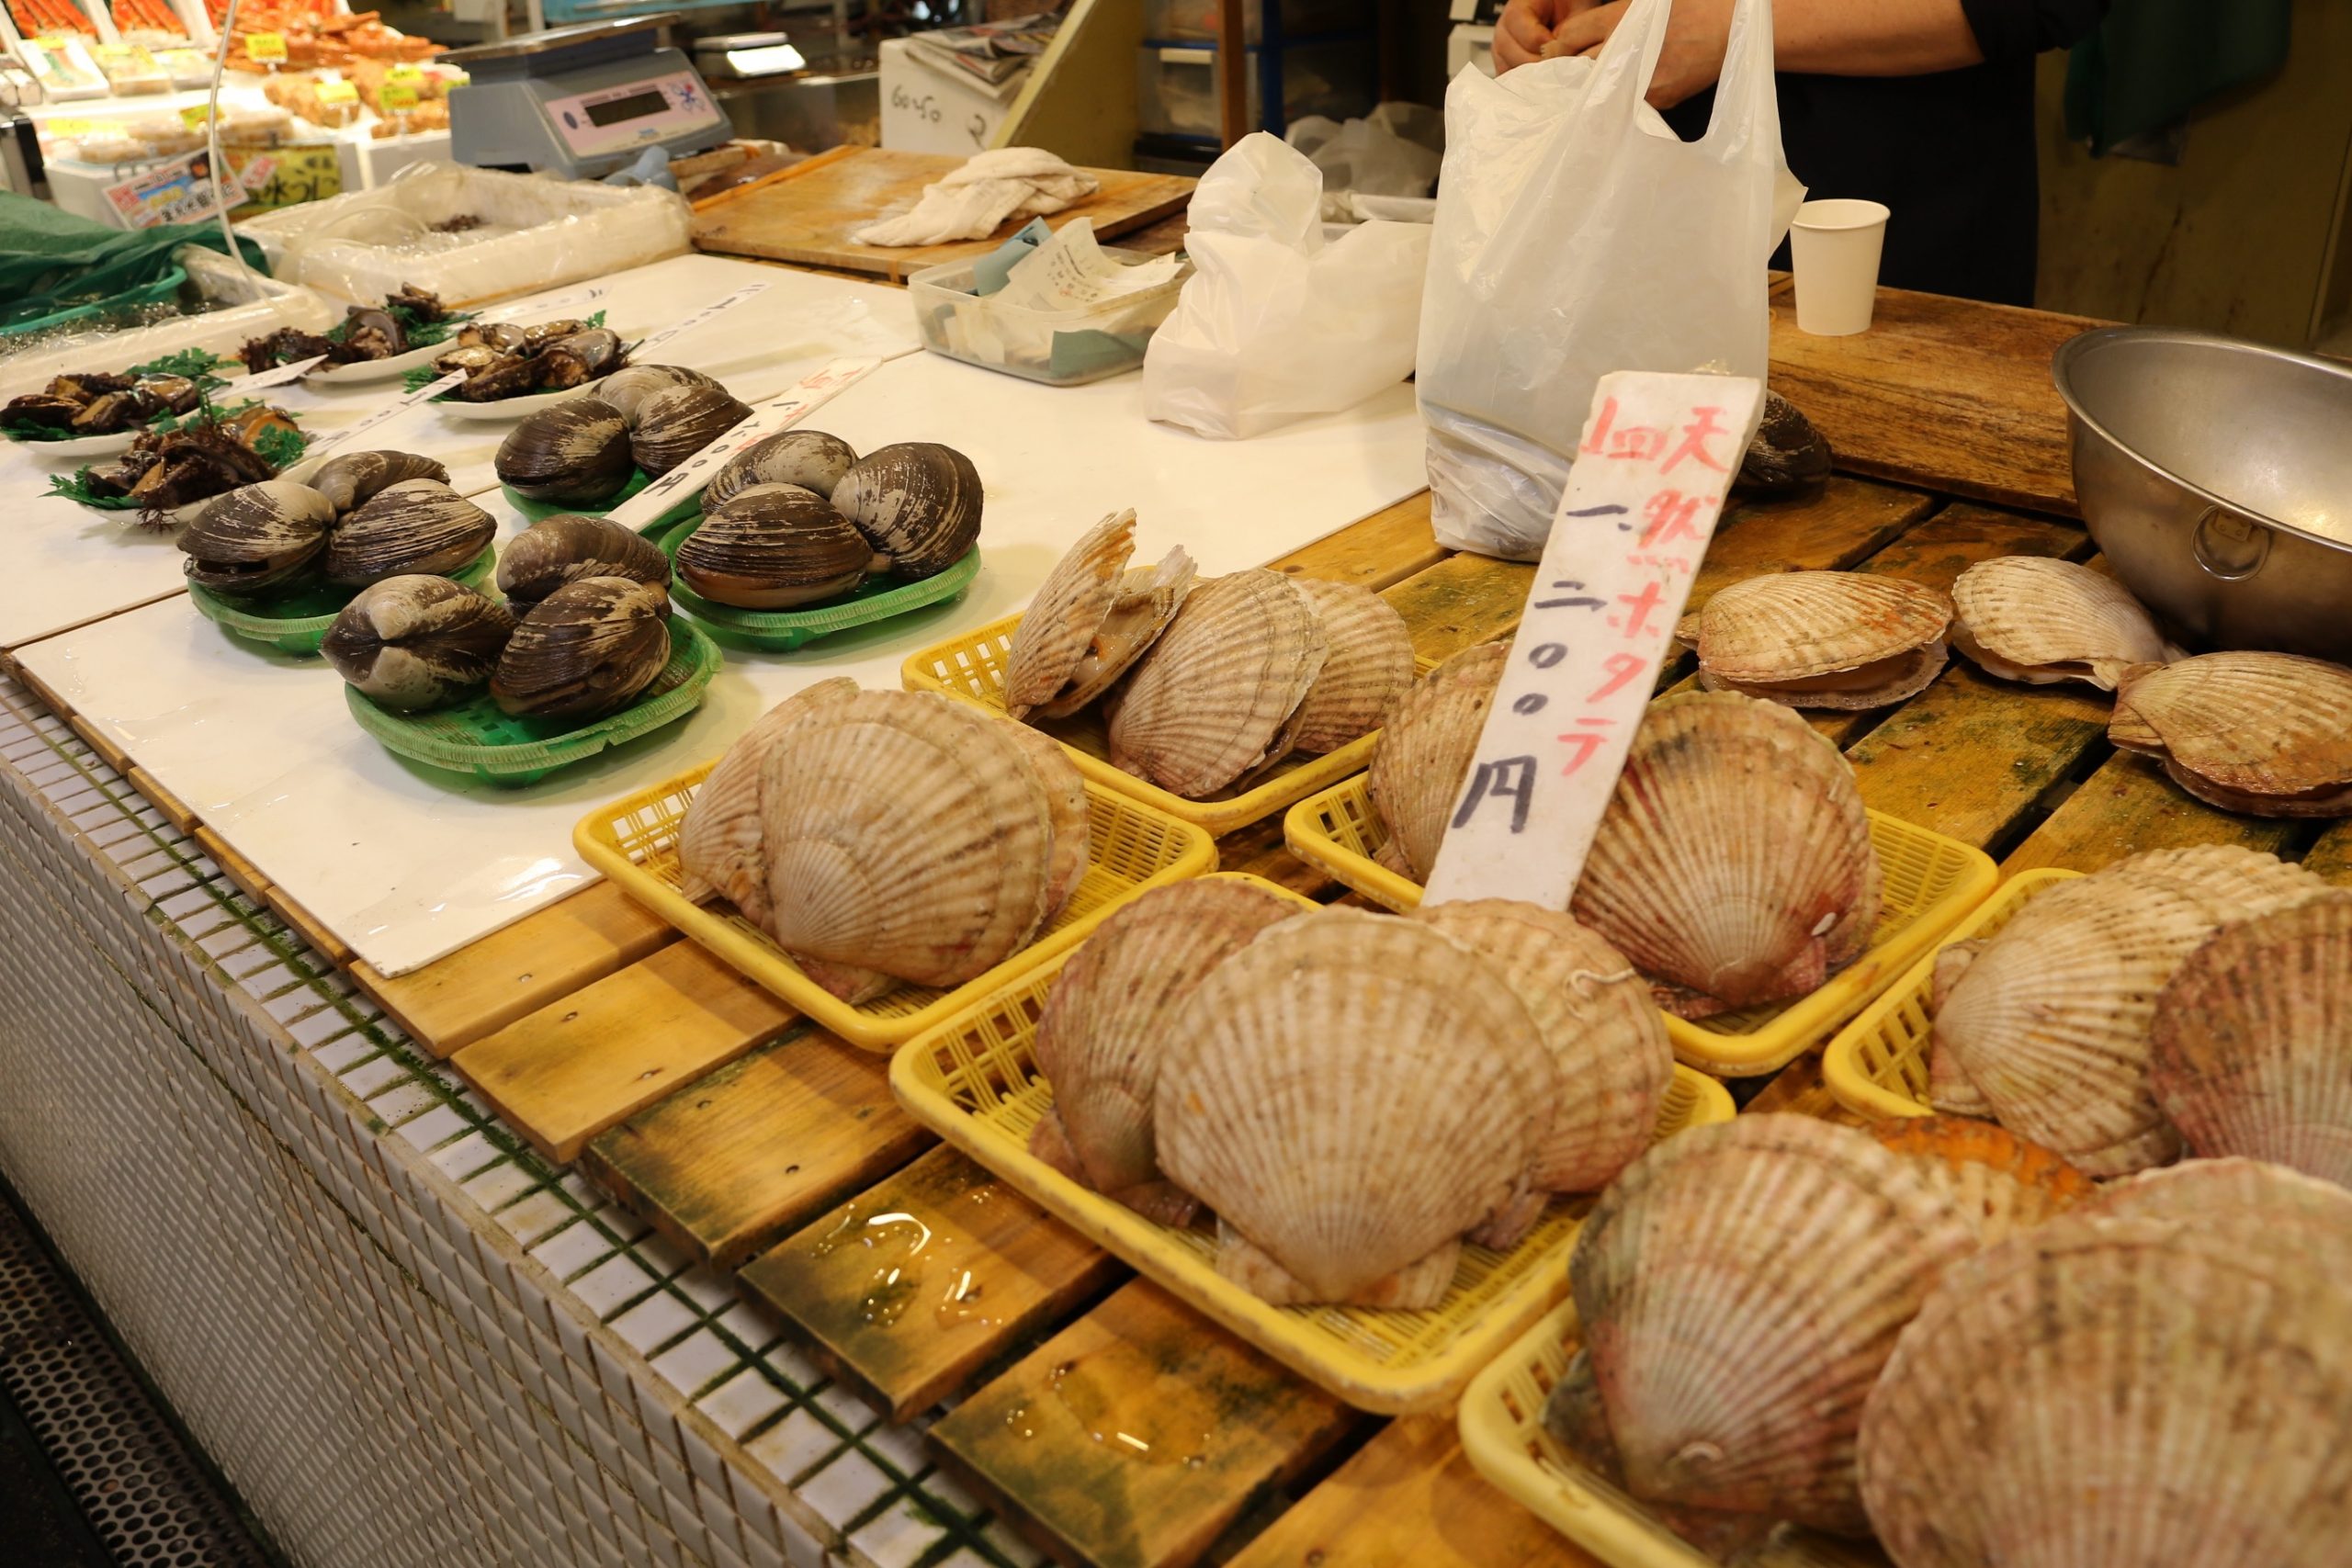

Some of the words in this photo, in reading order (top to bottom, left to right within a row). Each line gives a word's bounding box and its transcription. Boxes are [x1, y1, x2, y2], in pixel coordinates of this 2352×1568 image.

[1558, 405, 1734, 775] 天然ホタテ
